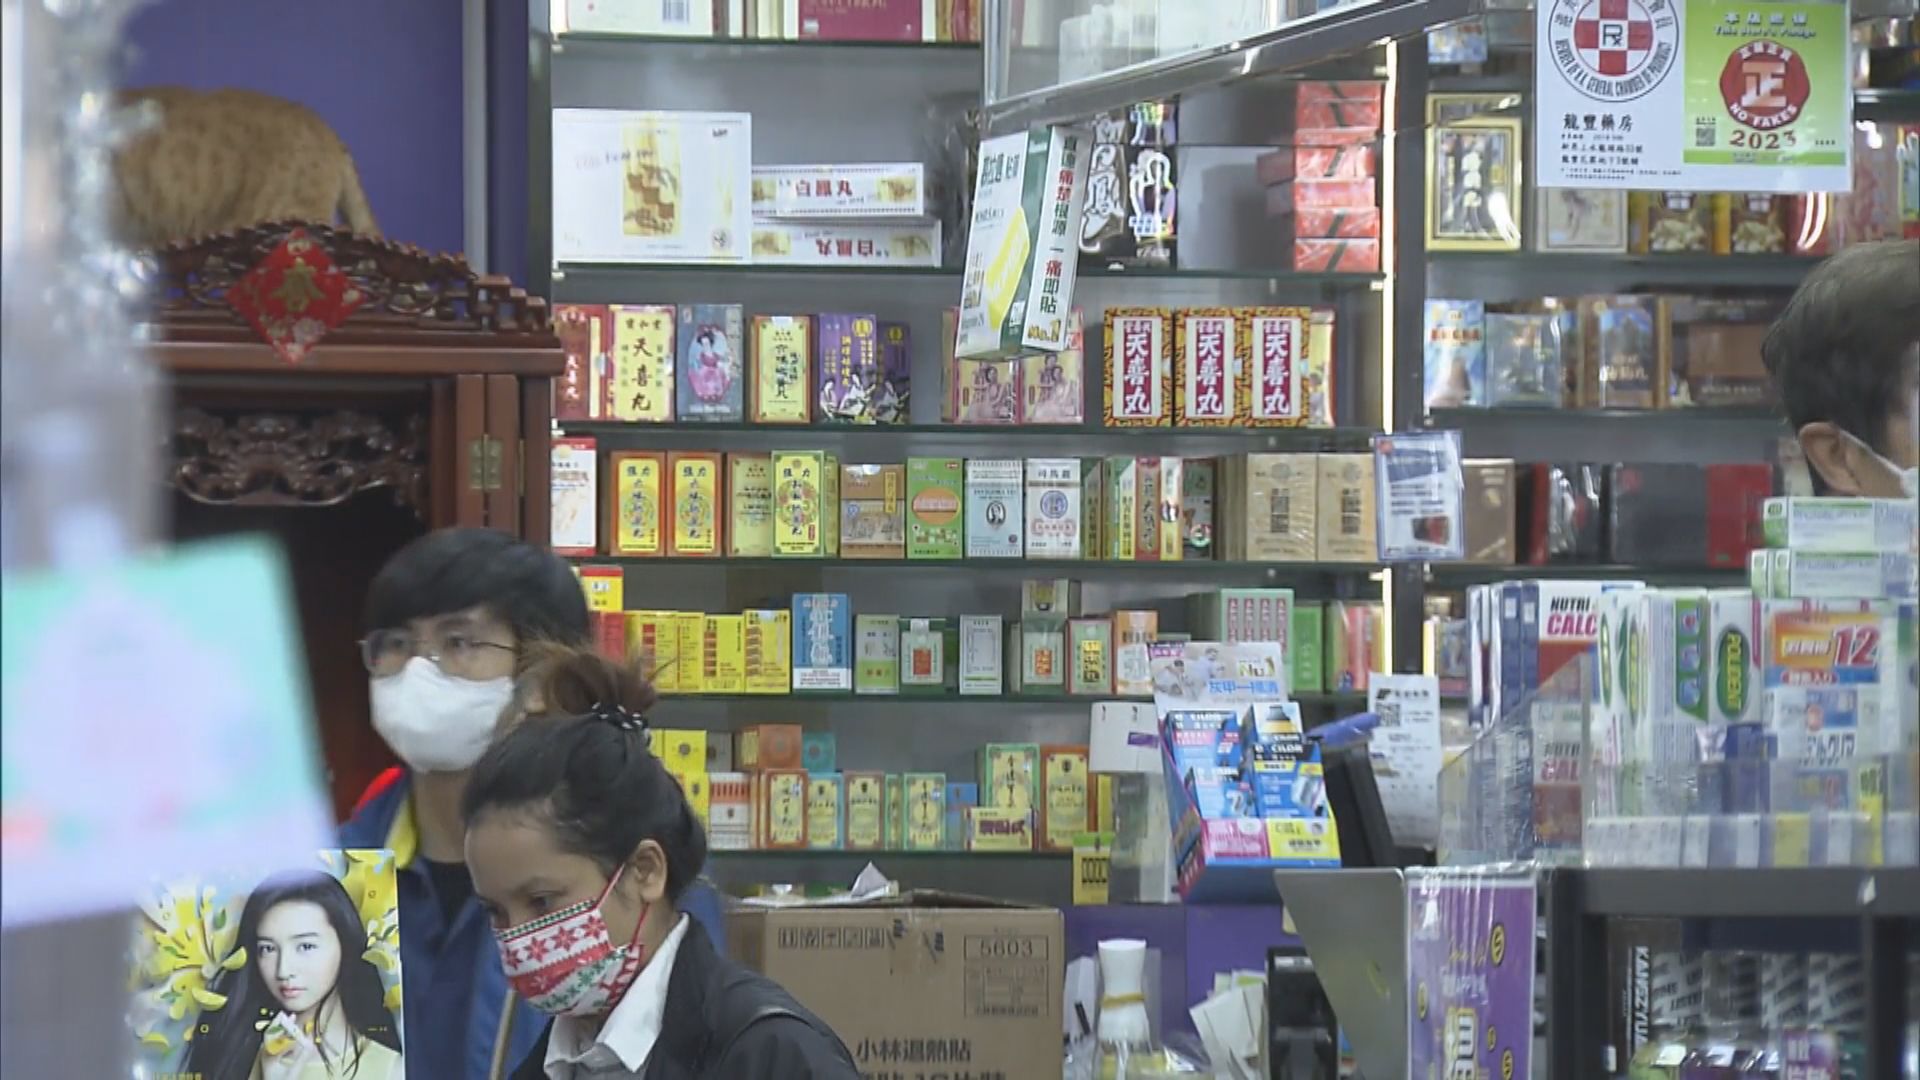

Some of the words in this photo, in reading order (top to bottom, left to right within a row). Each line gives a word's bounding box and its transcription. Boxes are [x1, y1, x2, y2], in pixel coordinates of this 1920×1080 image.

[1741, 61, 1787, 108] 正
[1730, 102, 1748, 121] NO
[1753, 104, 1798, 128] FAKES
[1730, 129, 1797, 150] 2023
[1125, 333, 1151, 415] 天喜丸
[1198, 333, 1223, 415] 天喜丸
[1264, 333, 1290, 415] 天喜丸
[1550, 597, 1590, 612] NUTRI
[1834, 625, 1881, 668] 12
